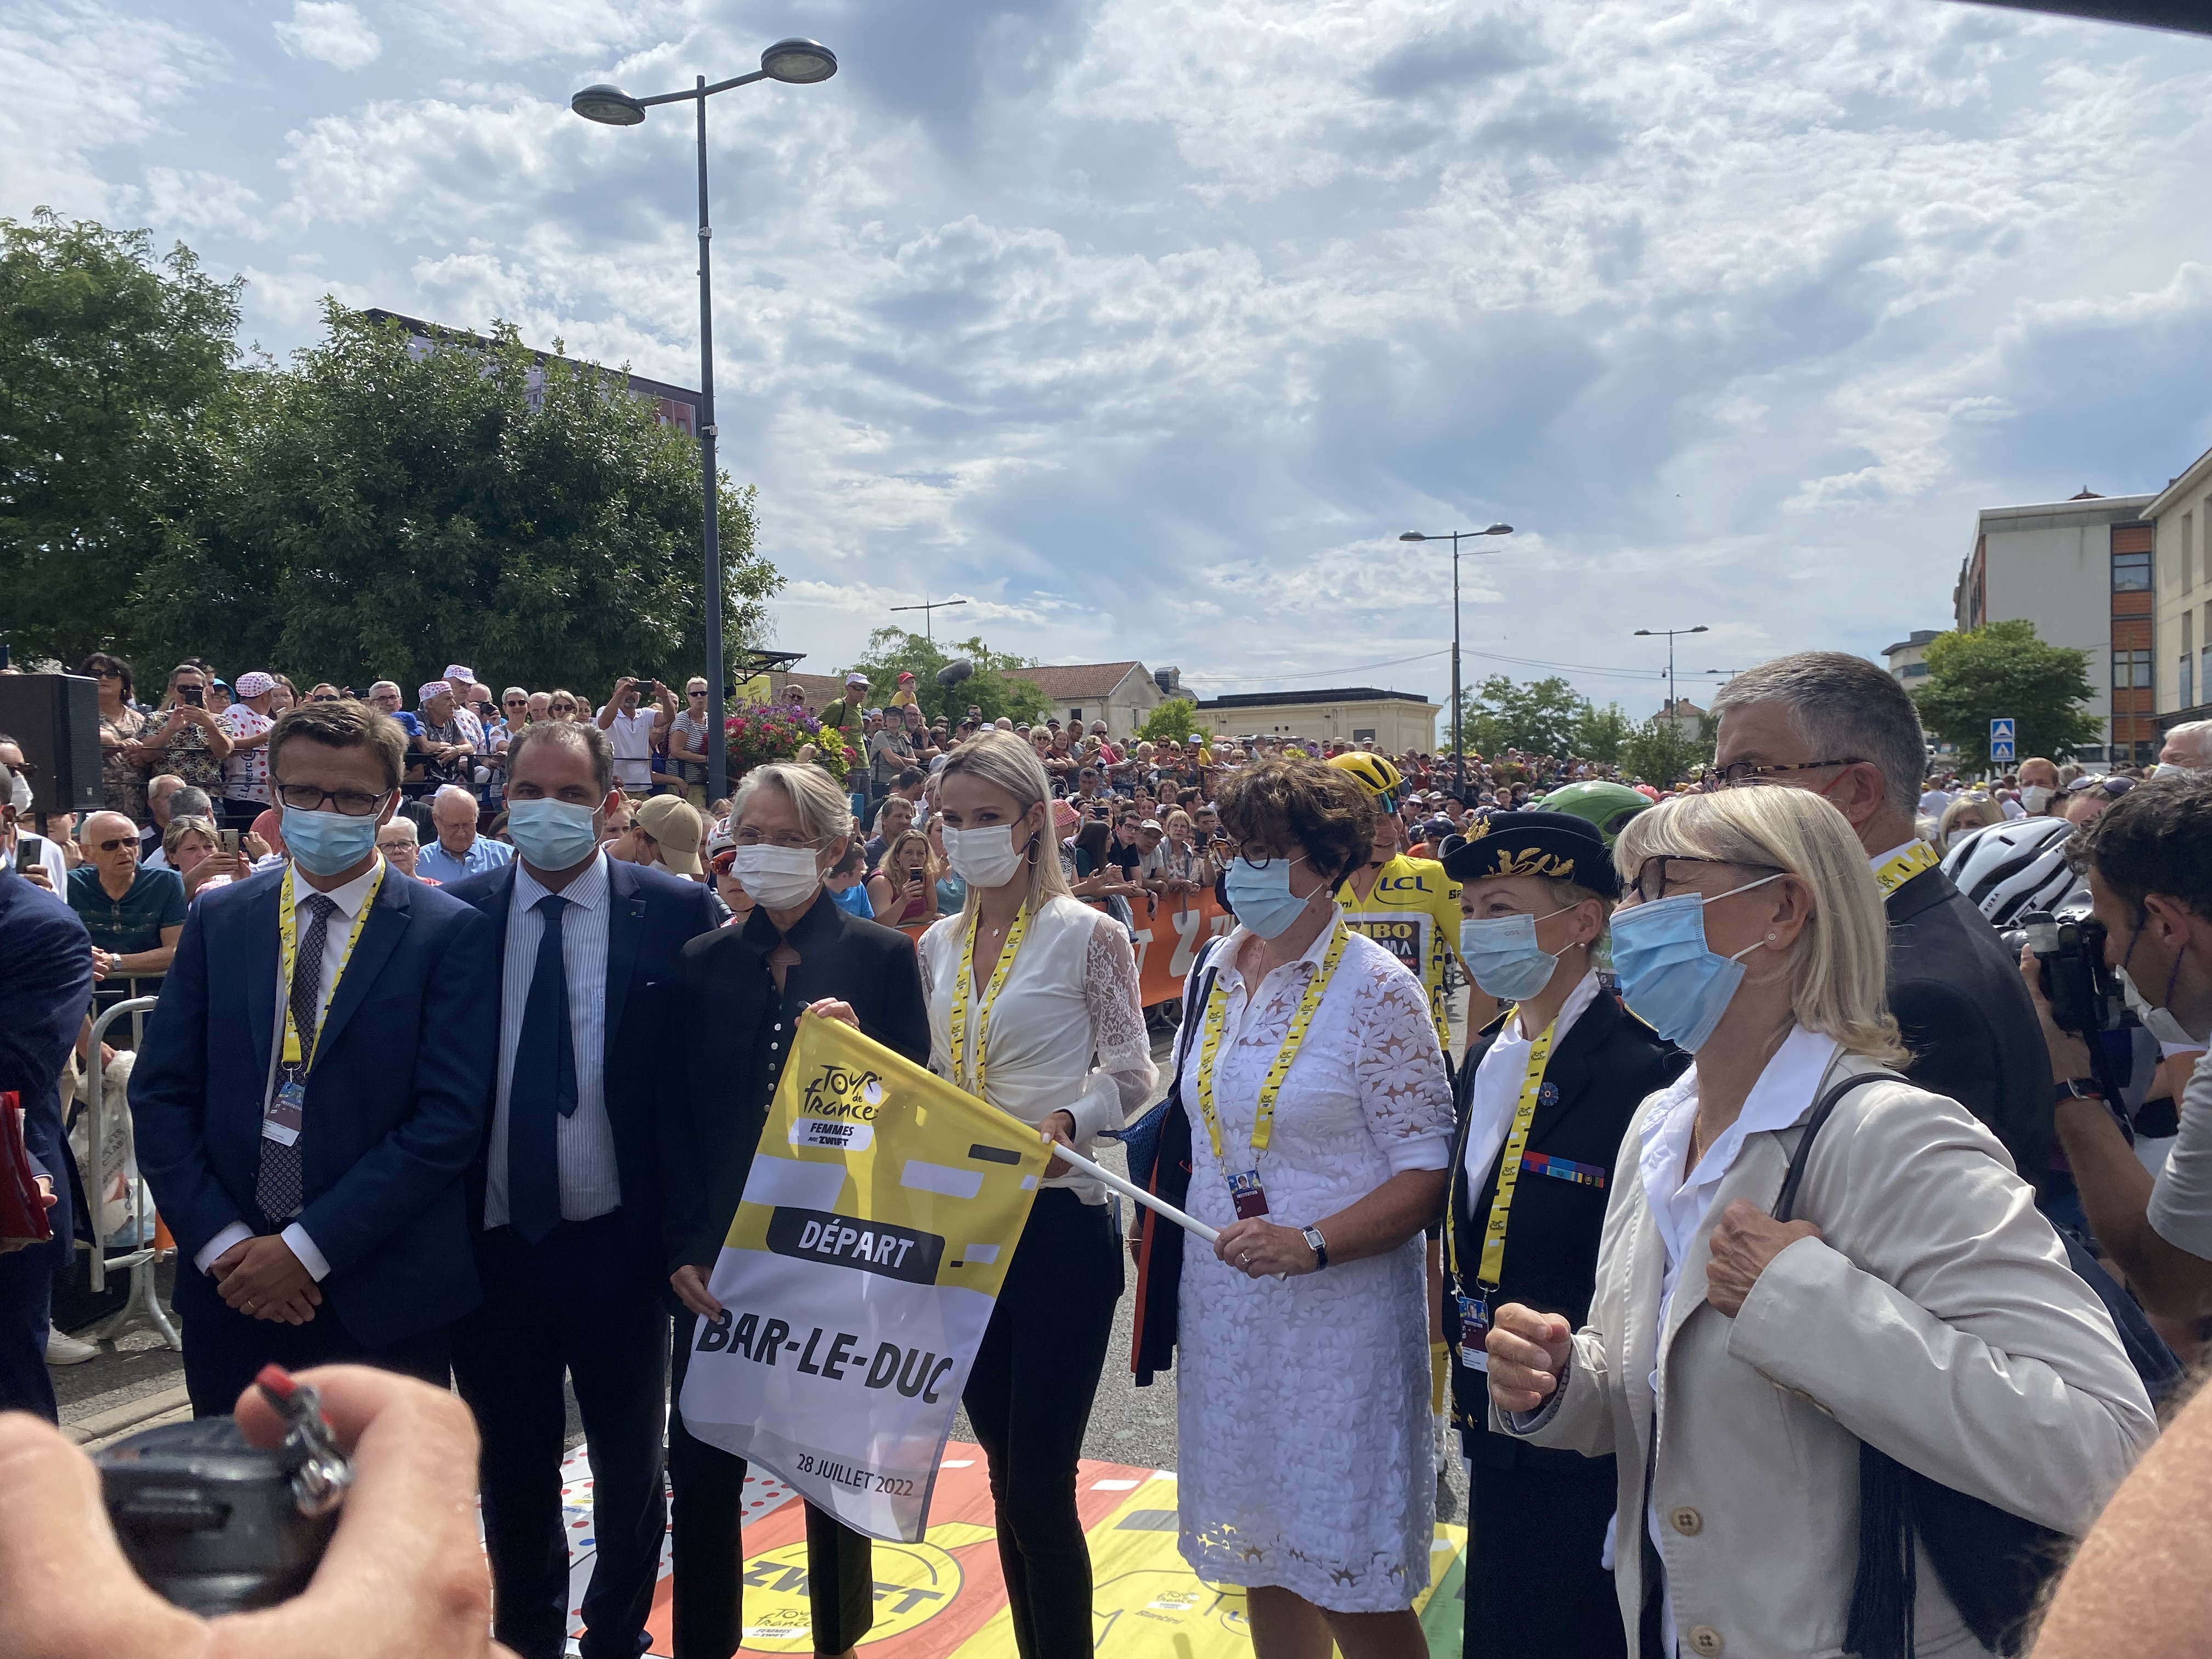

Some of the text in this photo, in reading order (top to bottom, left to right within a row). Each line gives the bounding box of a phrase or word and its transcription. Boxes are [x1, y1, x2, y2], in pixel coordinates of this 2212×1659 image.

[1380, 876, 1433, 893] LCL
[820, 1065, 879, 1095] TOUR
[852, 1092, 863, 1103] de
[810, 1122, 855, 1136] FEMMES
[819, 1136, 849, 1147] ZWIFT
[798, 1218, 915, 1268] DÉPART
[695, 1308, 953, 1404] BAR-LE-DUC
[796, 1453, 914, 1497] 28 JUILLET 2022
